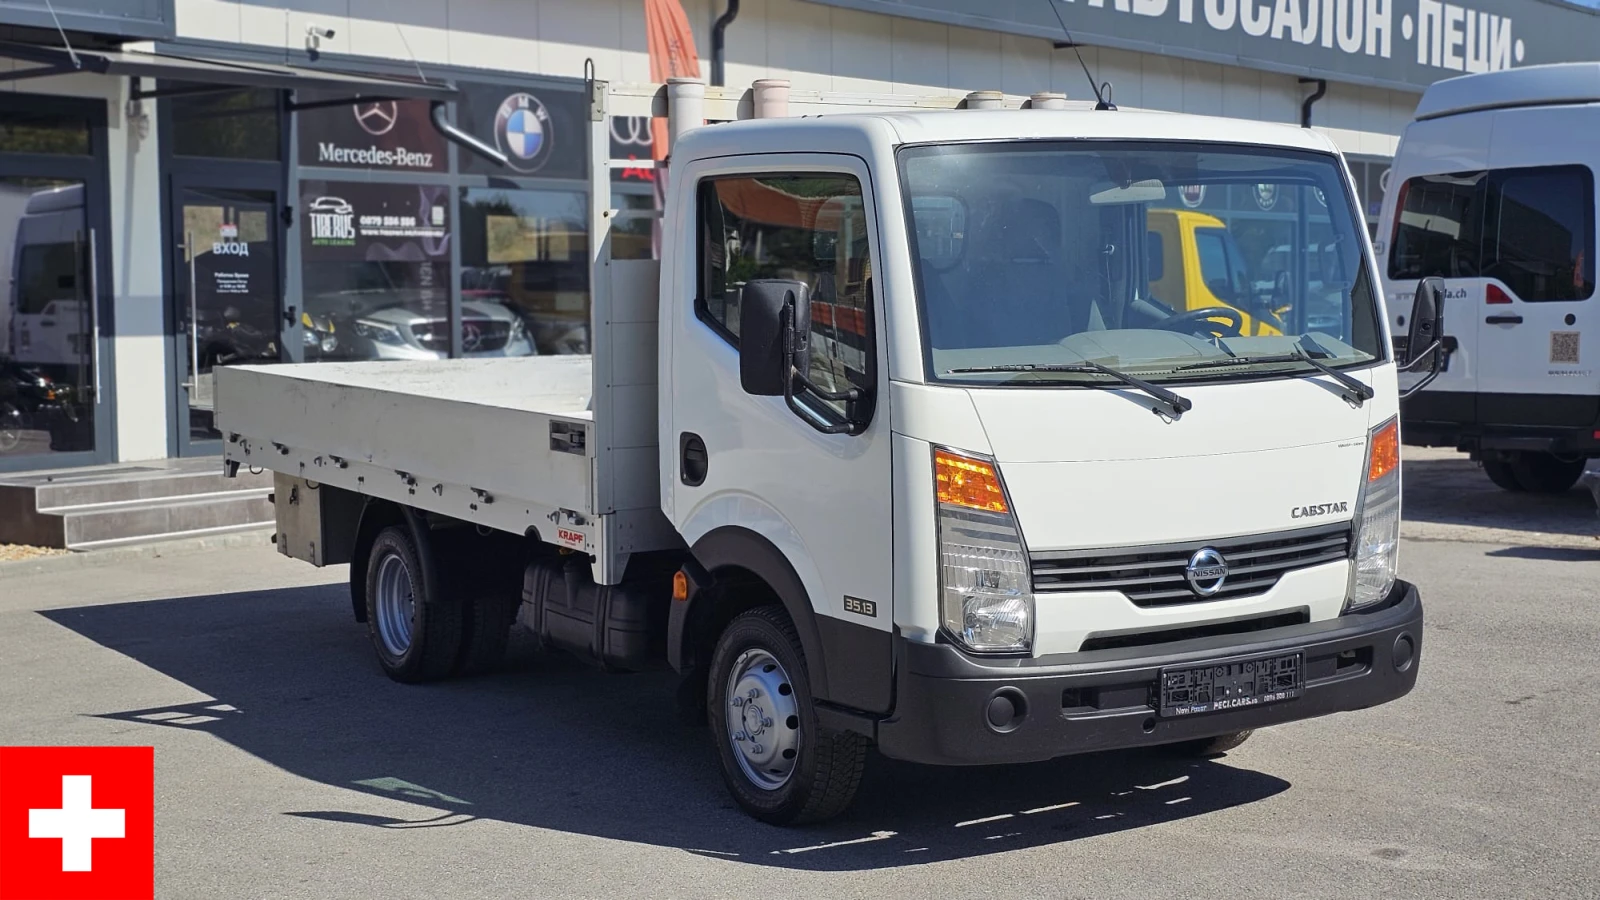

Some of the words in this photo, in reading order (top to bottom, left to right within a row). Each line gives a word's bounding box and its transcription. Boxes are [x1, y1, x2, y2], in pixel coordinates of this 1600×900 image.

[1087, 0, 1391, 58] САЛОН
[1417, 0, 1511, 73] ПЕЦИ
[319, 142, 433, 167] Mercedes-Benz
[309, 213, 355, 239] TIBERUS
[213, 242, 249, 257] ВХОД
[1291, 501, 1348, 518] CABSTAR
[558, 529, 583, 544] KRAPF
[1193, 568, 1226, 578] NISSAN
[846, 599, 873, 614] 35.13
[1175, 706, 1190, 715] Novi
